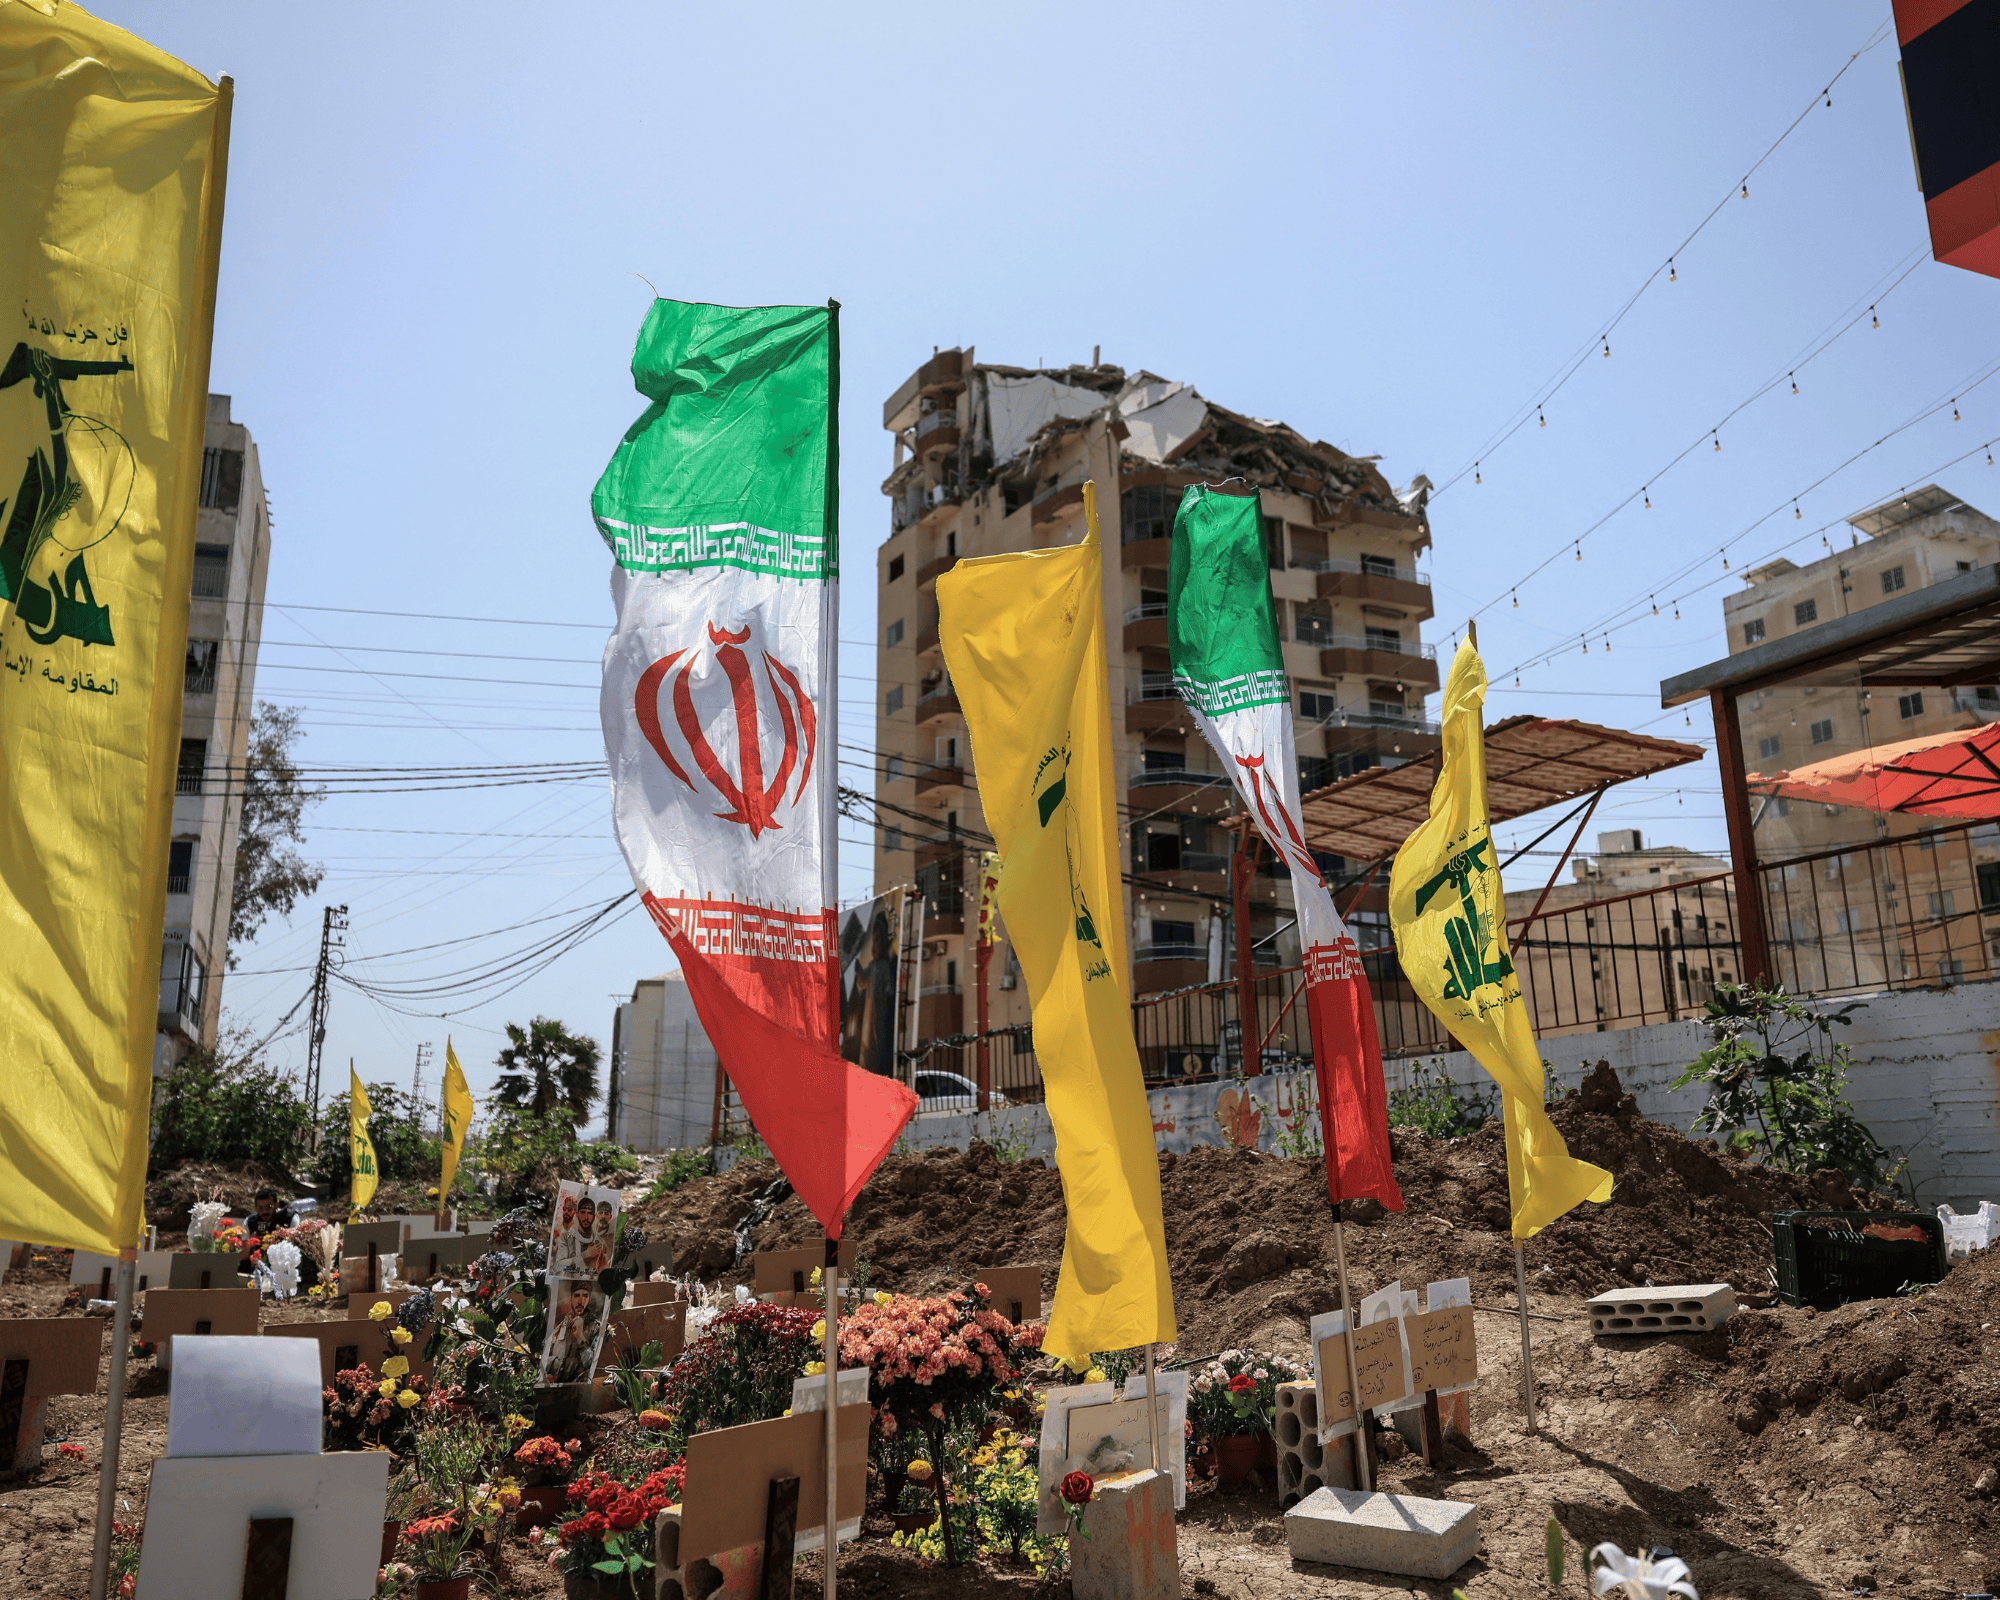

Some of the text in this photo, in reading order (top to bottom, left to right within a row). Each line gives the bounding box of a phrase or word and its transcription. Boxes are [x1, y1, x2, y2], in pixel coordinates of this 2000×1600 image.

[41, 317, 56, 335] الله
[62, 323, 98, 345] حزب
[105, 322, 128, 346] فإن
[42, 659, 118, 696] المقاومة
[1458, 828, 1469, 842] الله
